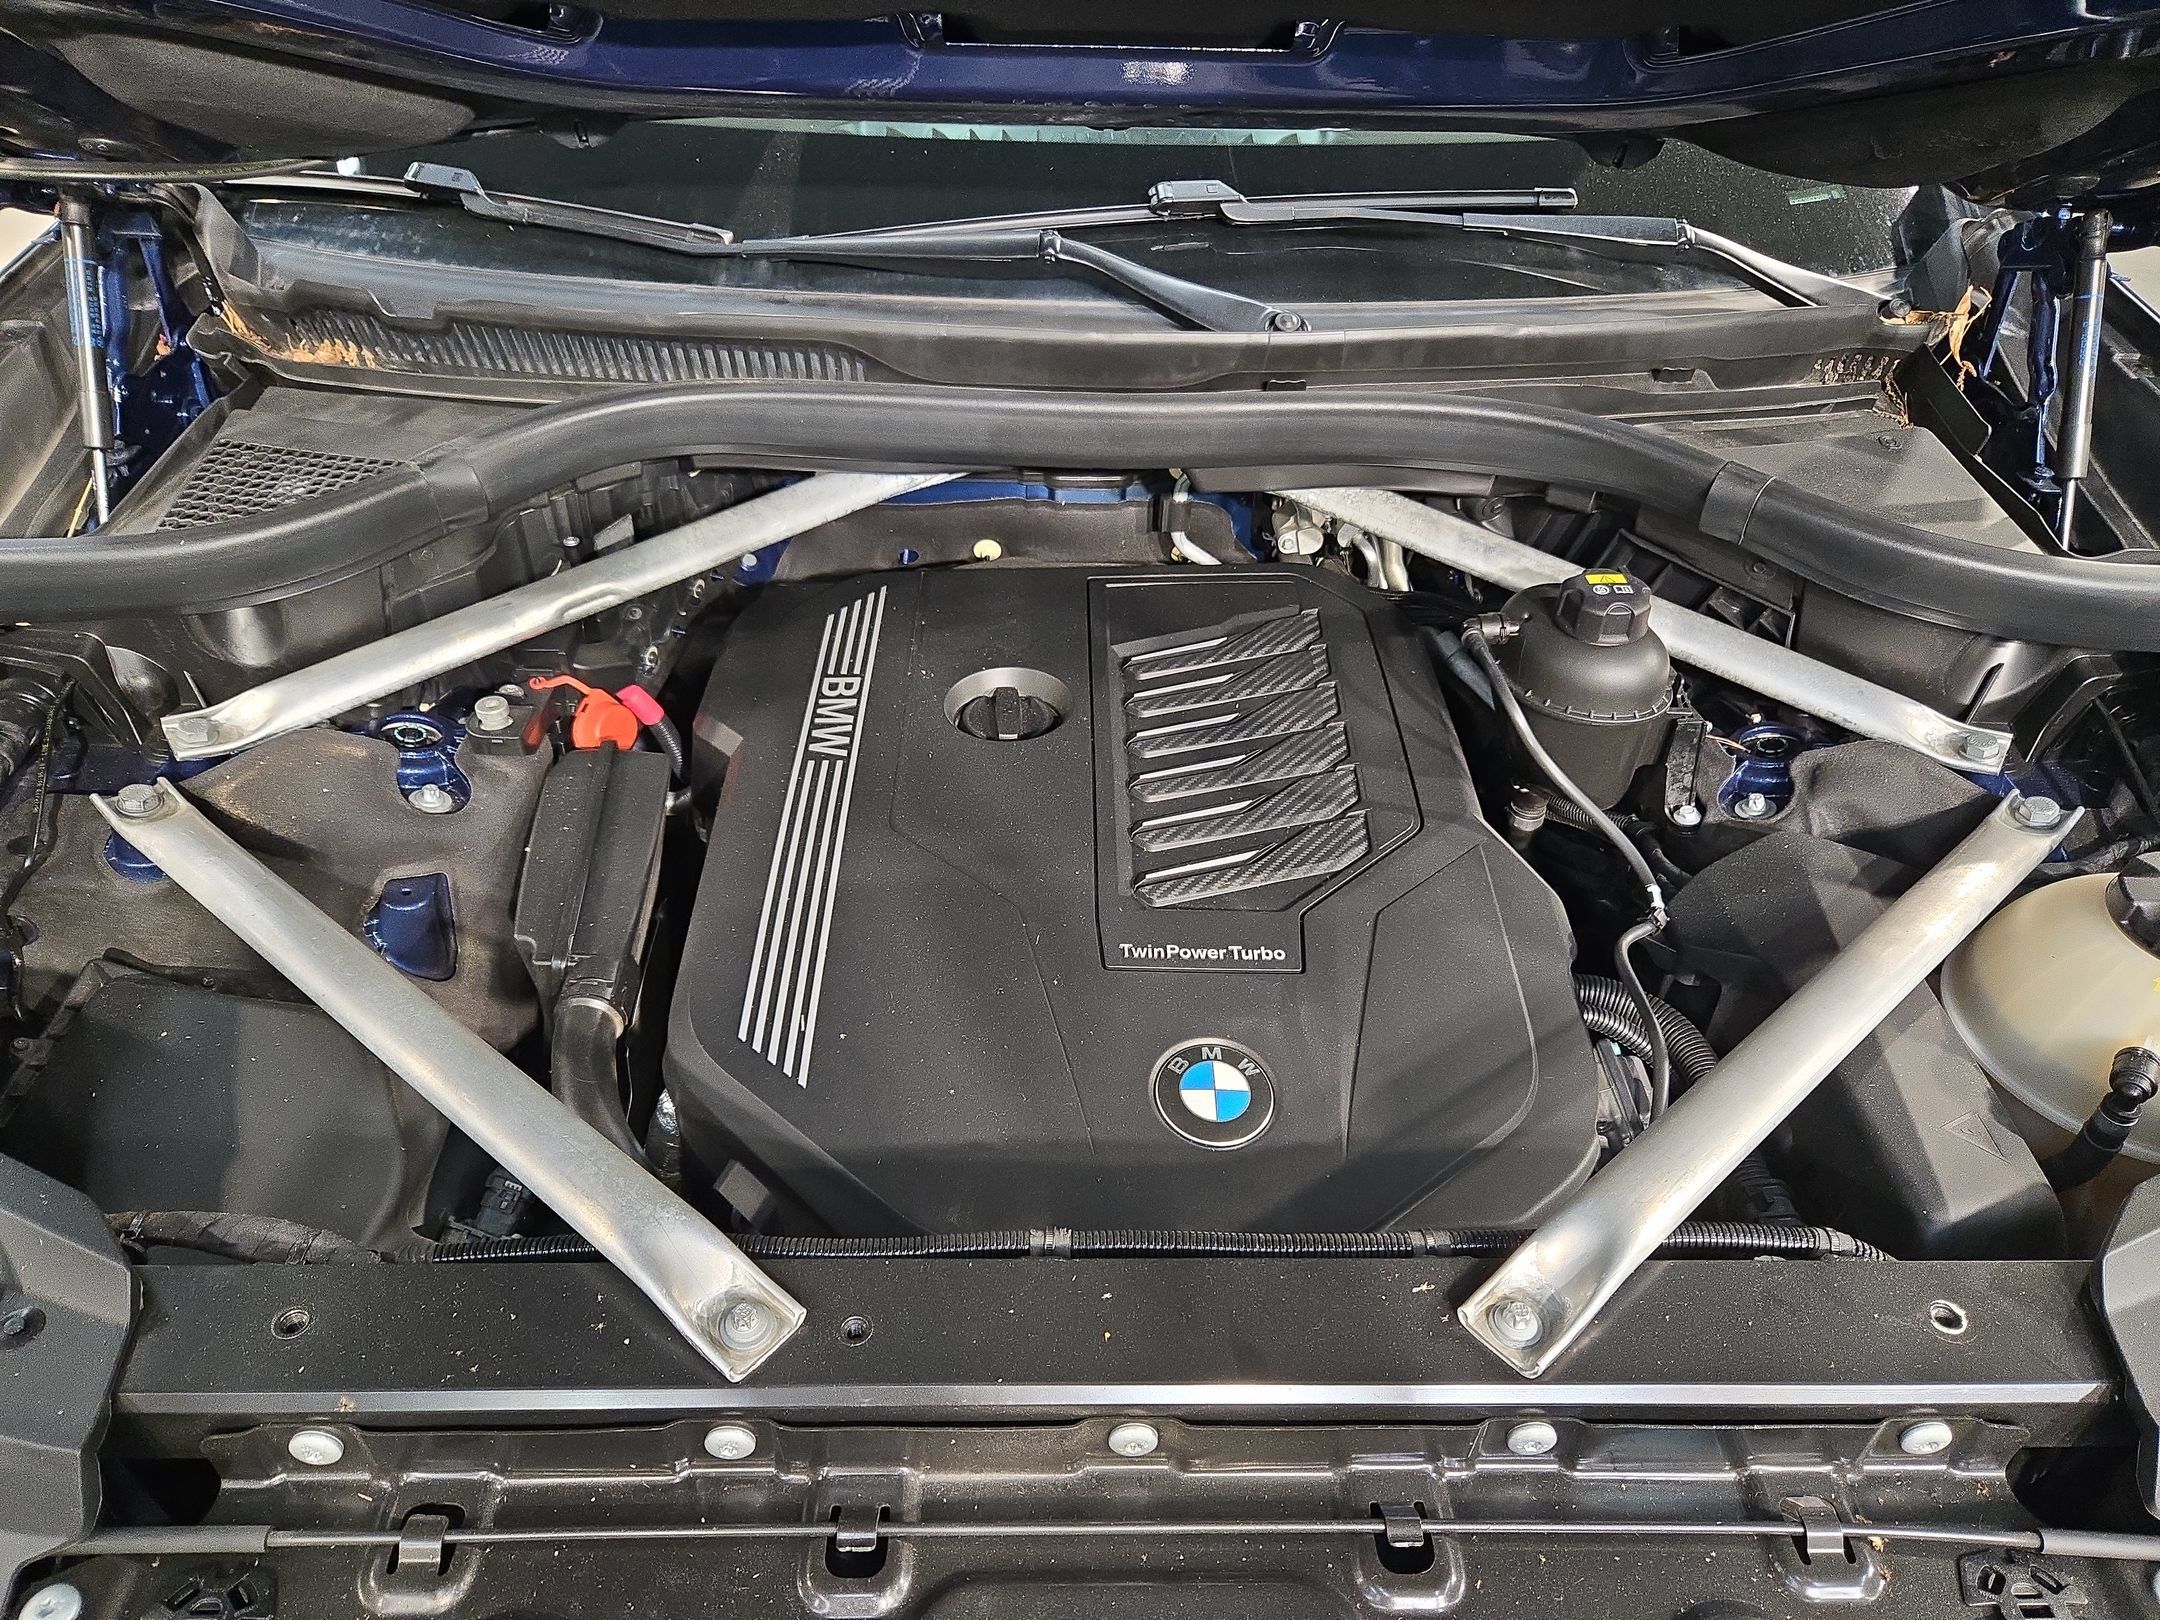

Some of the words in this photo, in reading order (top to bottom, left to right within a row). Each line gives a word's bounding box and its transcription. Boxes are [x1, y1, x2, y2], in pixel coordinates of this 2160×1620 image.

[808, 677, 862, 757] BMW
[1228, 945, 1287, 961] Turbo
[1167, 1046, 1261, 1077] BMW
